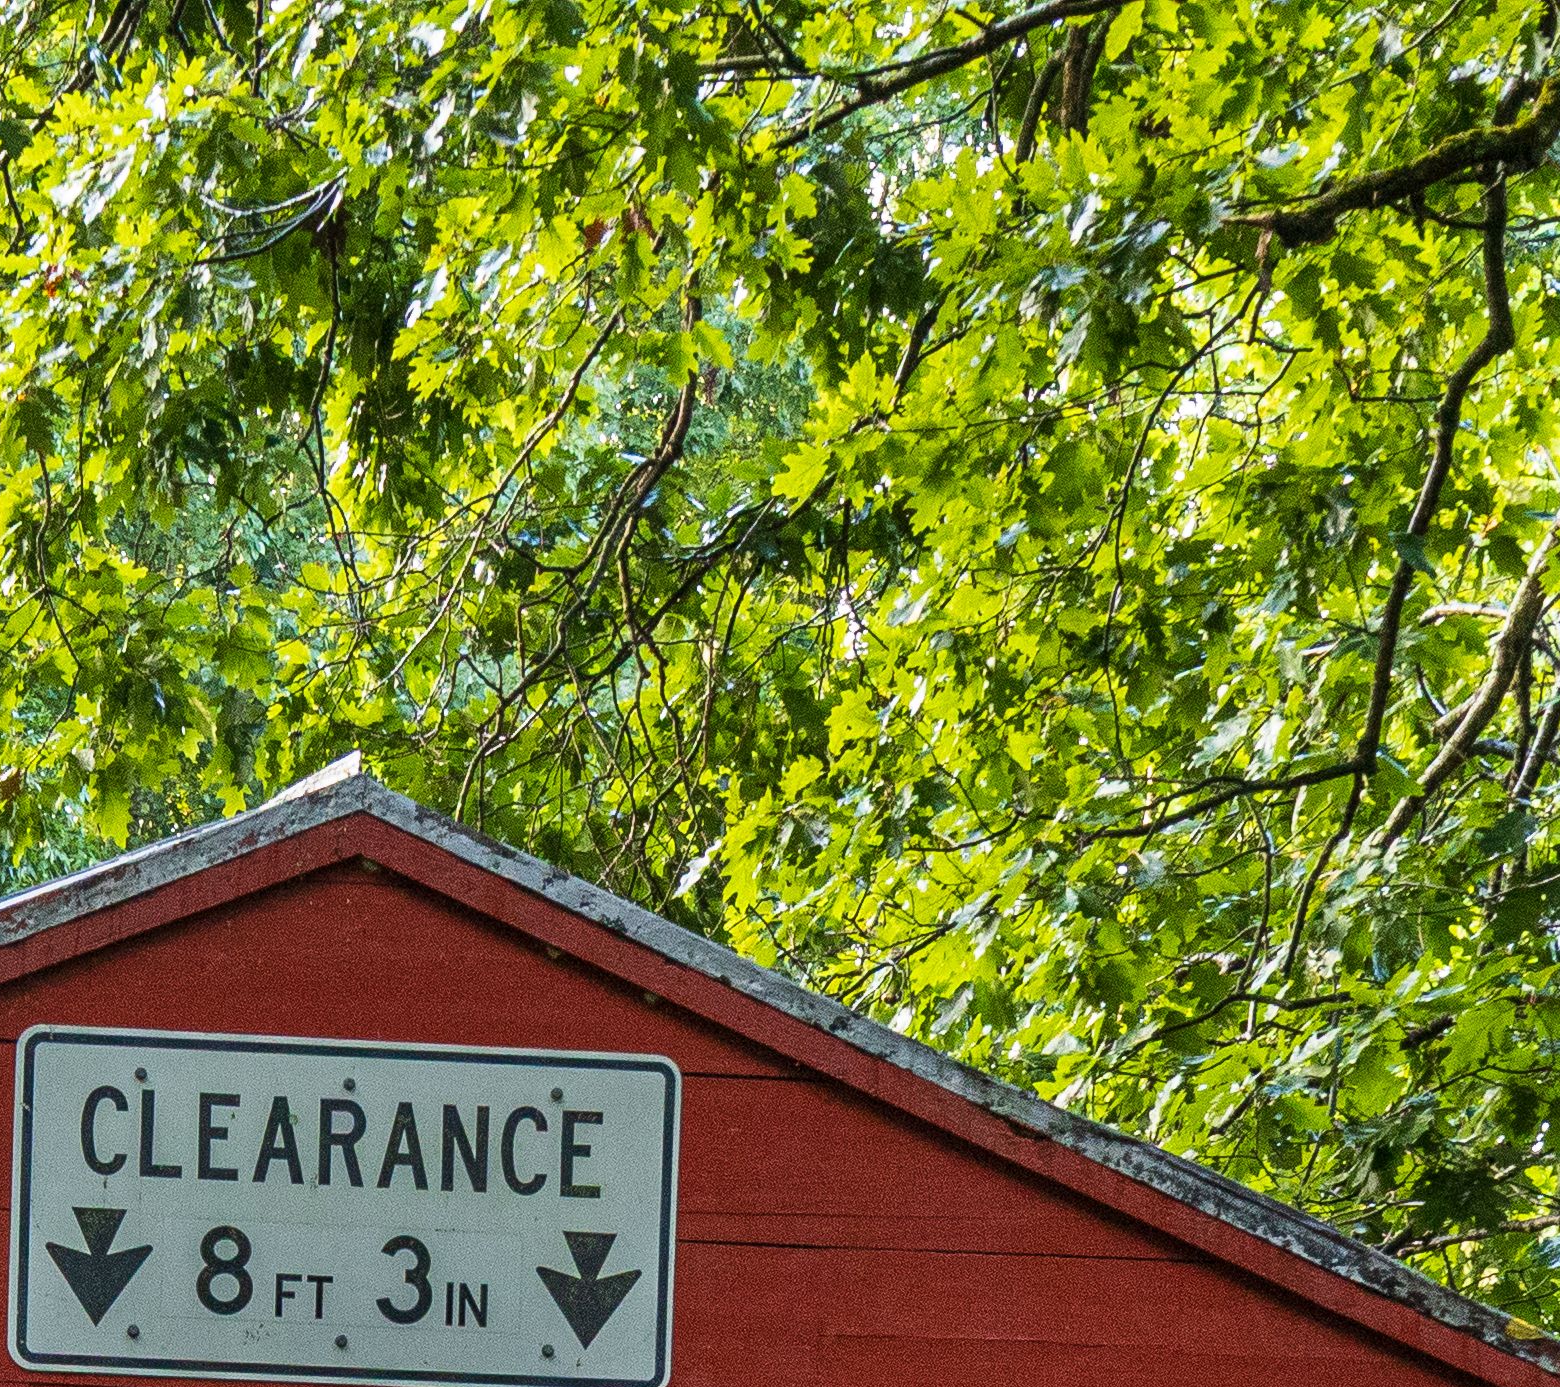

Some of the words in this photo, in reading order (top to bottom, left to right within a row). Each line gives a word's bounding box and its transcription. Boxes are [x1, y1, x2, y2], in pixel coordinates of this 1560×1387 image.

[79, 1084, 605, 1199] CLEARANCE
[195, 1225, 254, 1316] 8
[274, 1274, 334, 1320] FT
[375, 1235, 433, 1325] 3
[445, 1282, 488, 1328] IN
